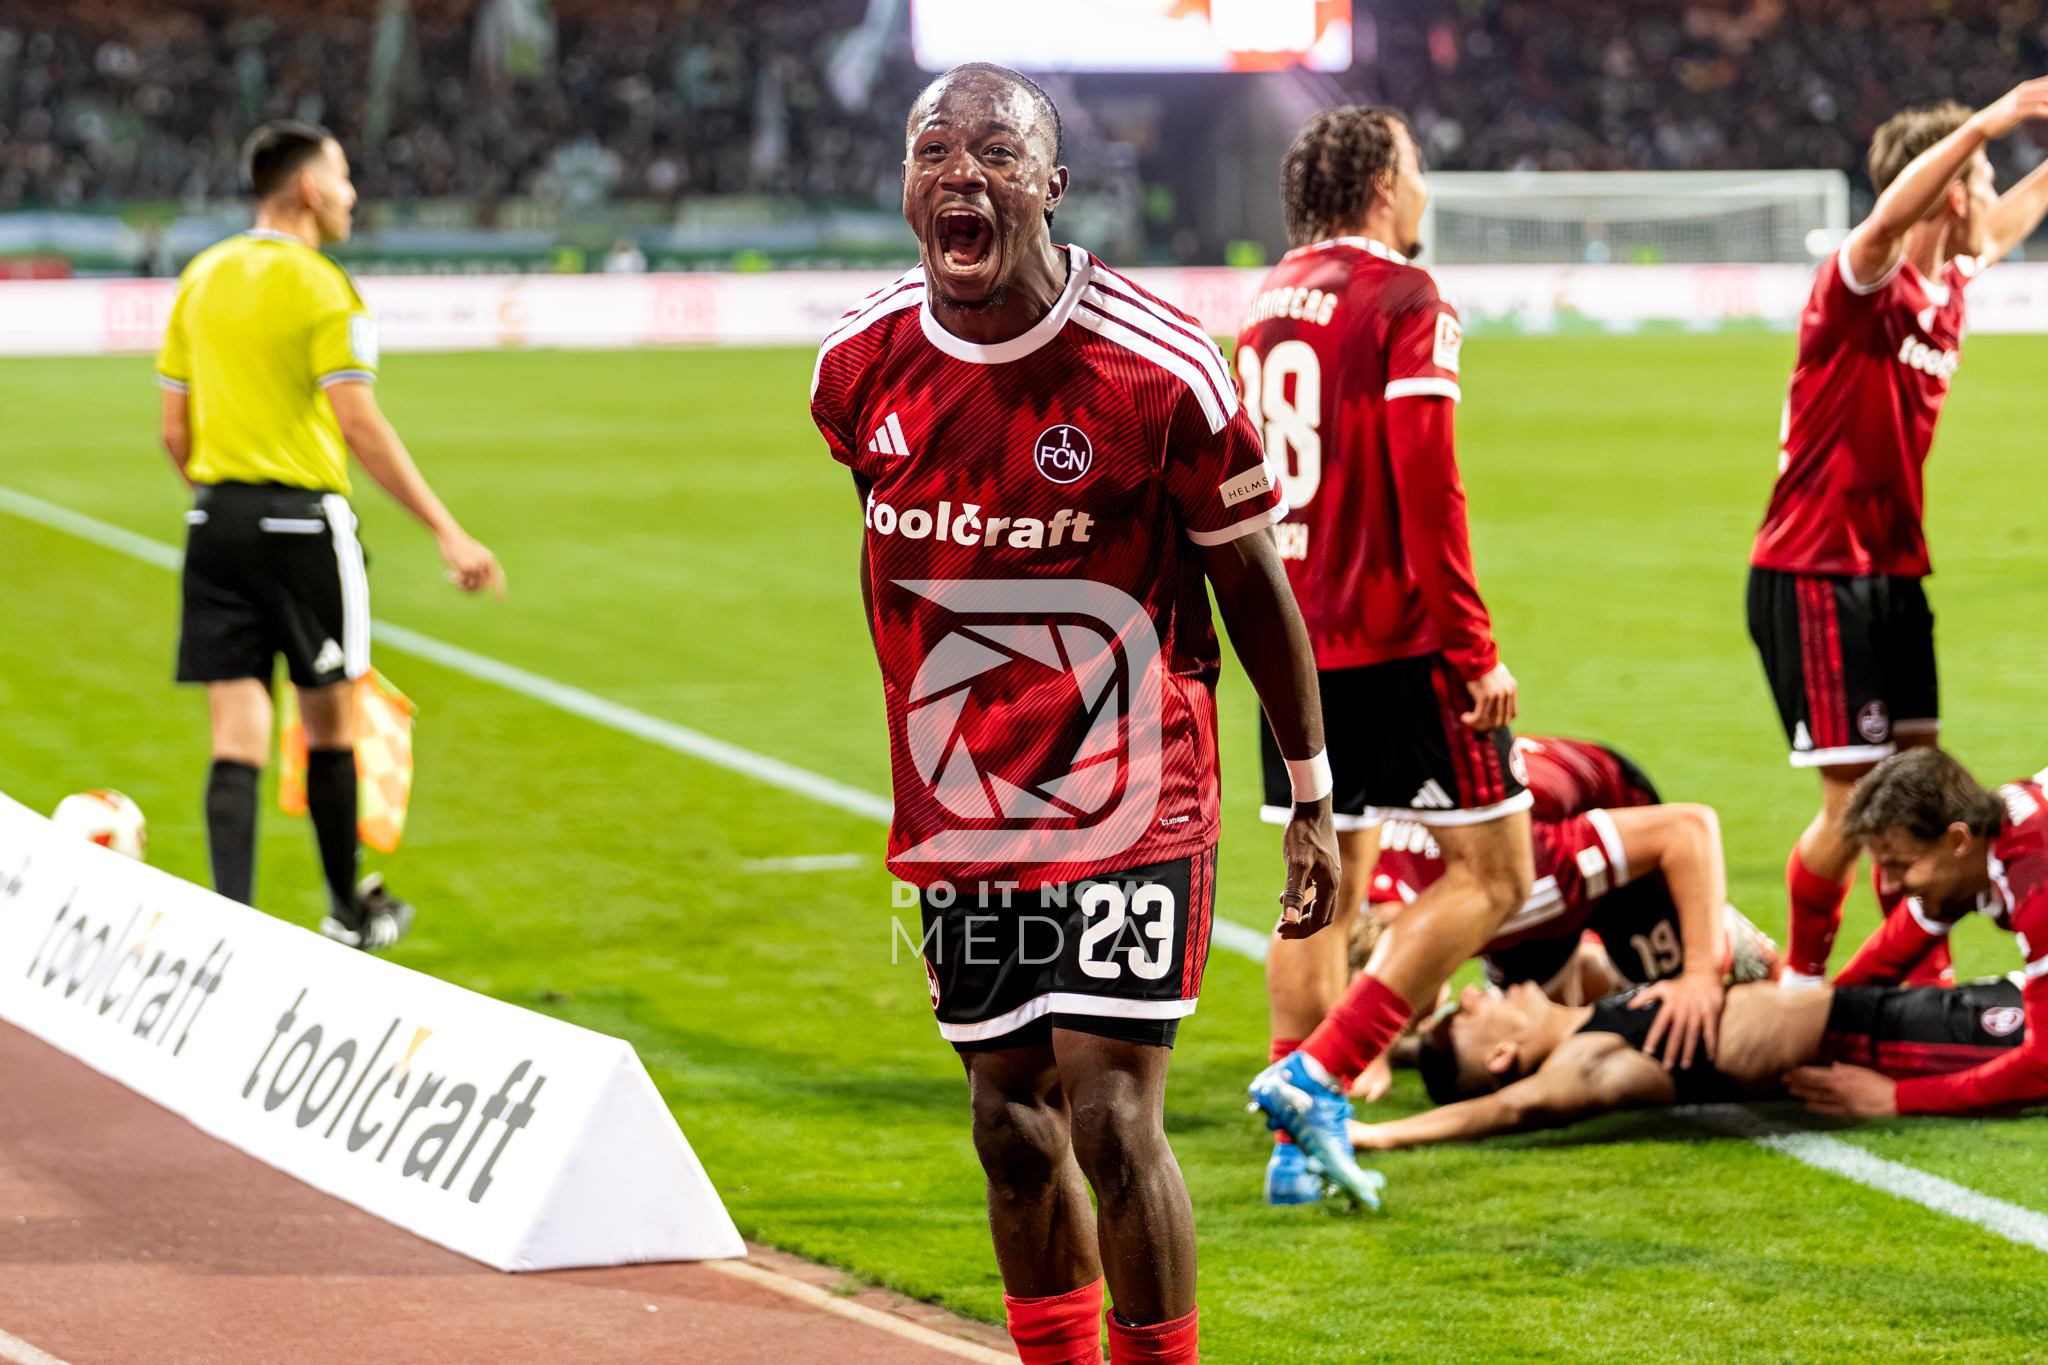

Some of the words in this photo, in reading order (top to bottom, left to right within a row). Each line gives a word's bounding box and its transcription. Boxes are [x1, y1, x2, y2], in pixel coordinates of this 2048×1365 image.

[1040, 445, 1086, 472] FCN
[1059, 427, 1071, 449] 1.
[866, 488, 1095, 549] toolcraft
[1078, 883, 1175, 980] 23
[1629, 918, 1681, 980] 19
